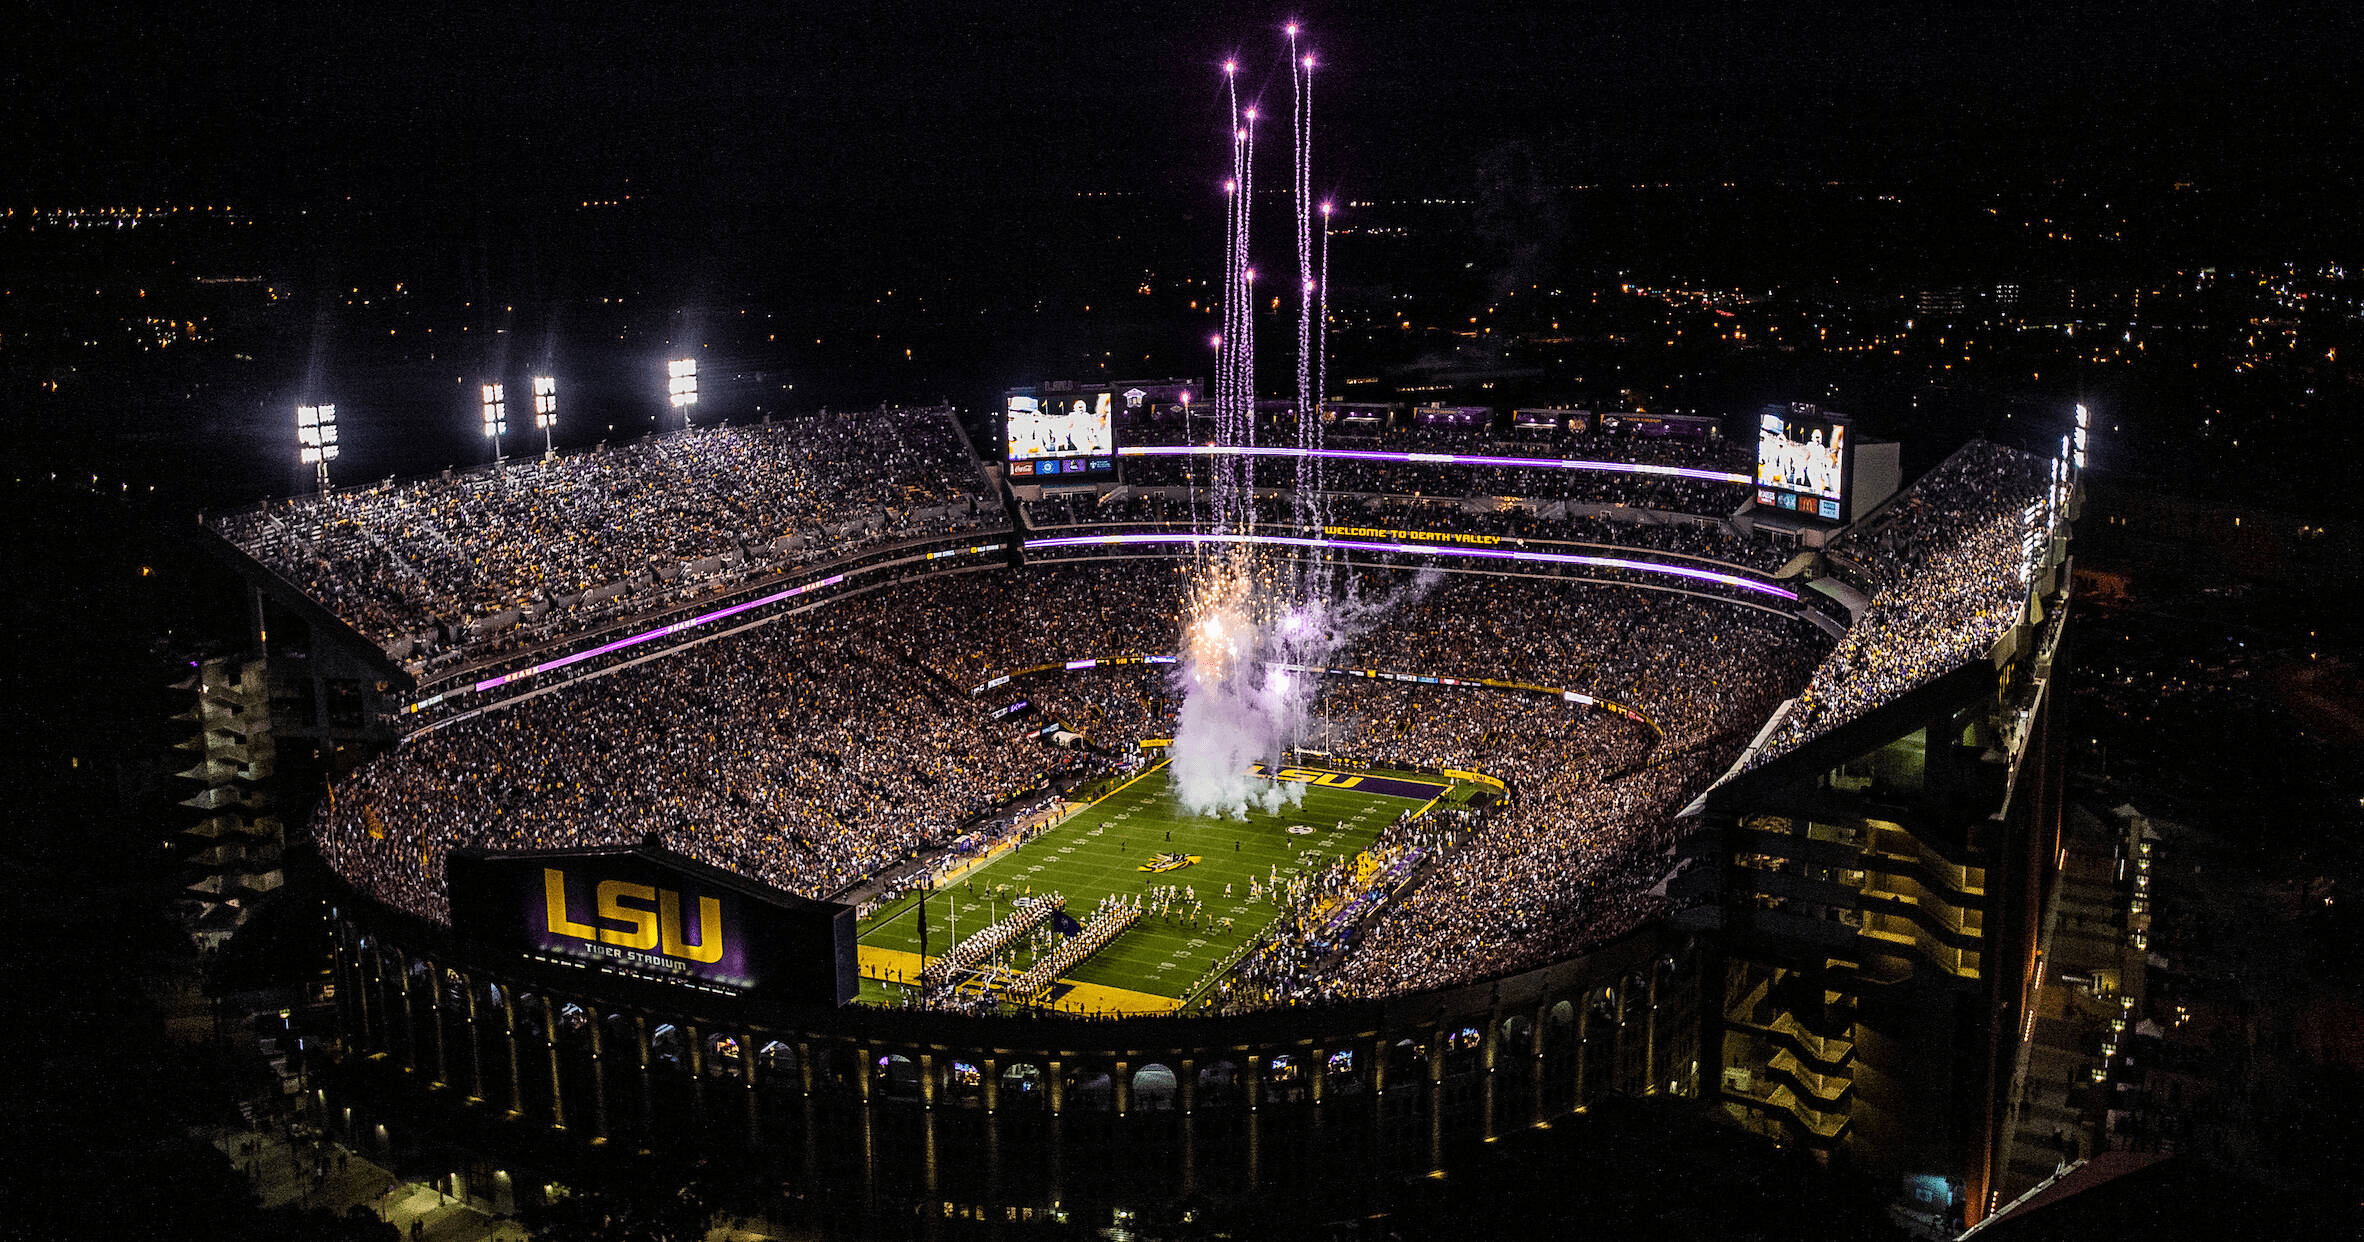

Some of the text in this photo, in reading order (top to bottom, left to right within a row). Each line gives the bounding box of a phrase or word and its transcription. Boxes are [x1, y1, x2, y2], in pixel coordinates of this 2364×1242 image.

[1324, 526, 1501, 545] WELCOME TO DEATH VALLEY
[1245, 765, 1365, 788] LSU
[544, 867, 723, 964] LSU
[584, 943, 687, 971] TIGER STADIUM
